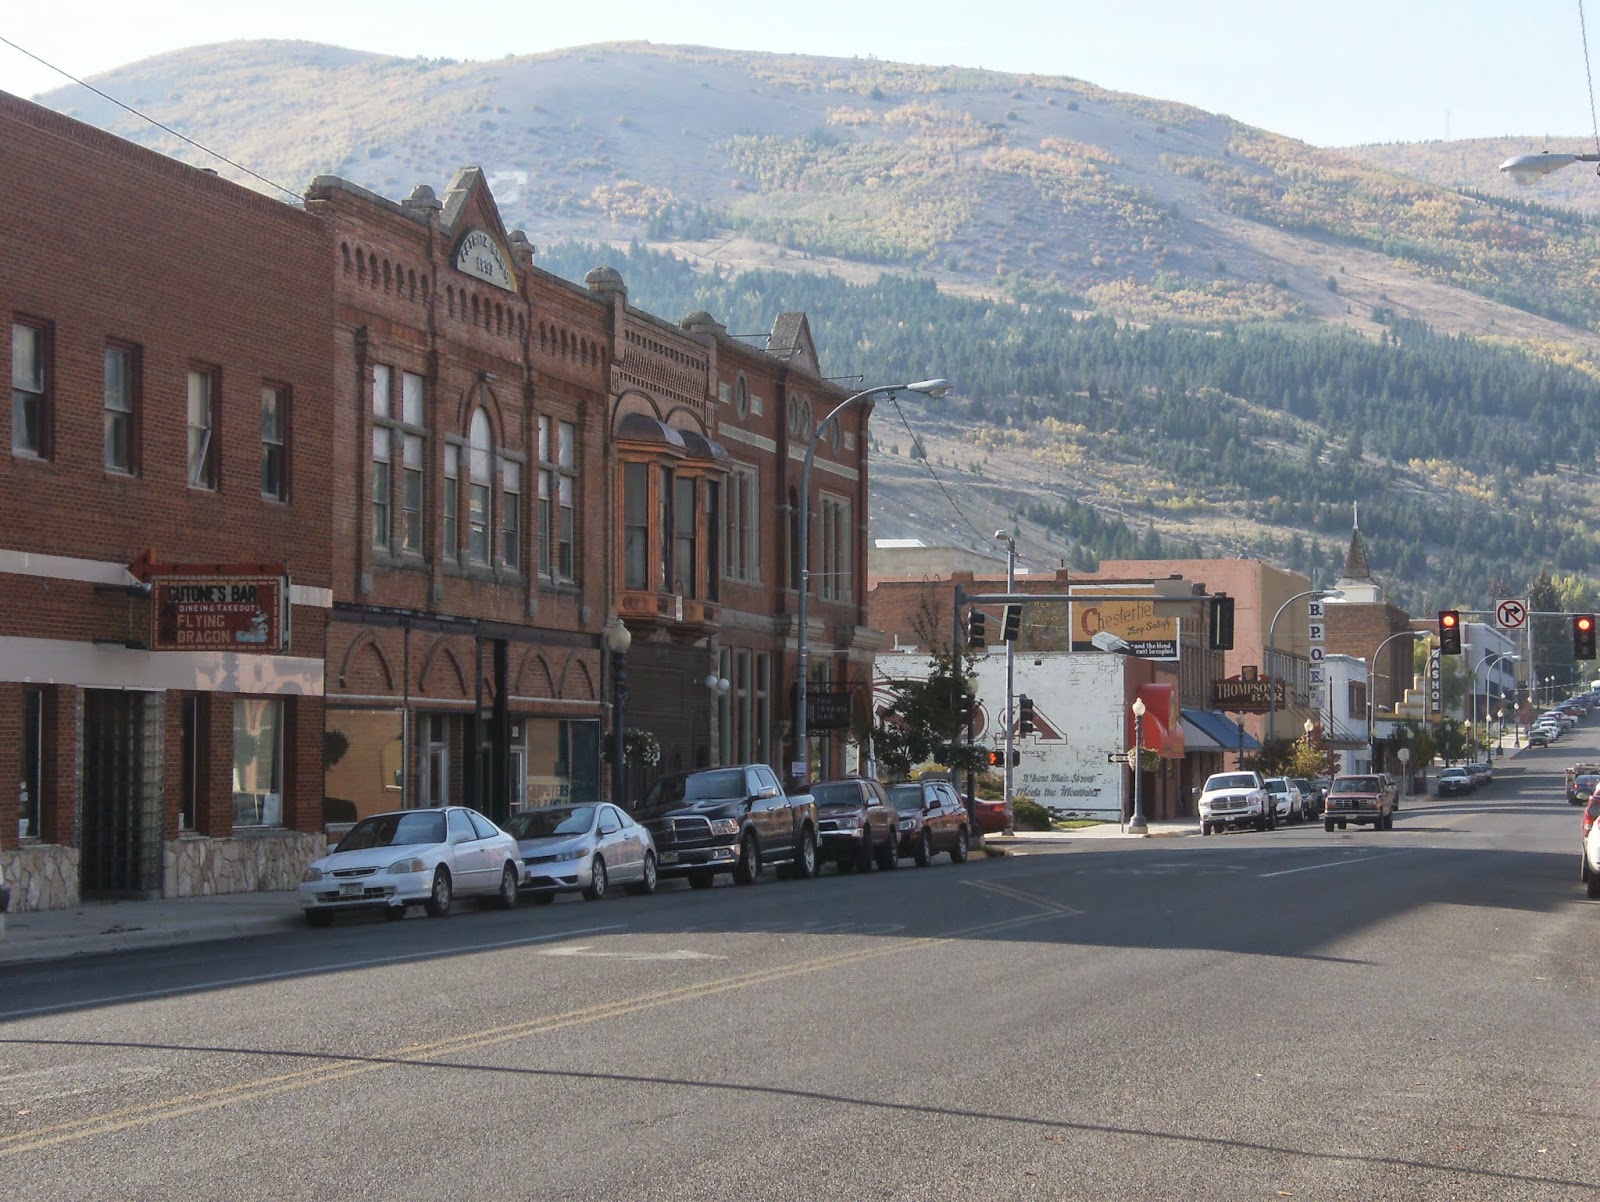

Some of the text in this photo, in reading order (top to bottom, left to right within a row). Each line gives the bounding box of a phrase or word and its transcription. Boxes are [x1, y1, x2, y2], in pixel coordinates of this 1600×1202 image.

[231, 585, 256, 602] BAR
[179, 604, 199, 612] DINE
[177, 614, 225, 628] FLYING
[1081, 600, 1155, 636] Chesterfie
[177, 630, 231, 643] DRAGON
[1251, 692, 1283, 701] BAR
[1044, 787, 1056, 797] the
